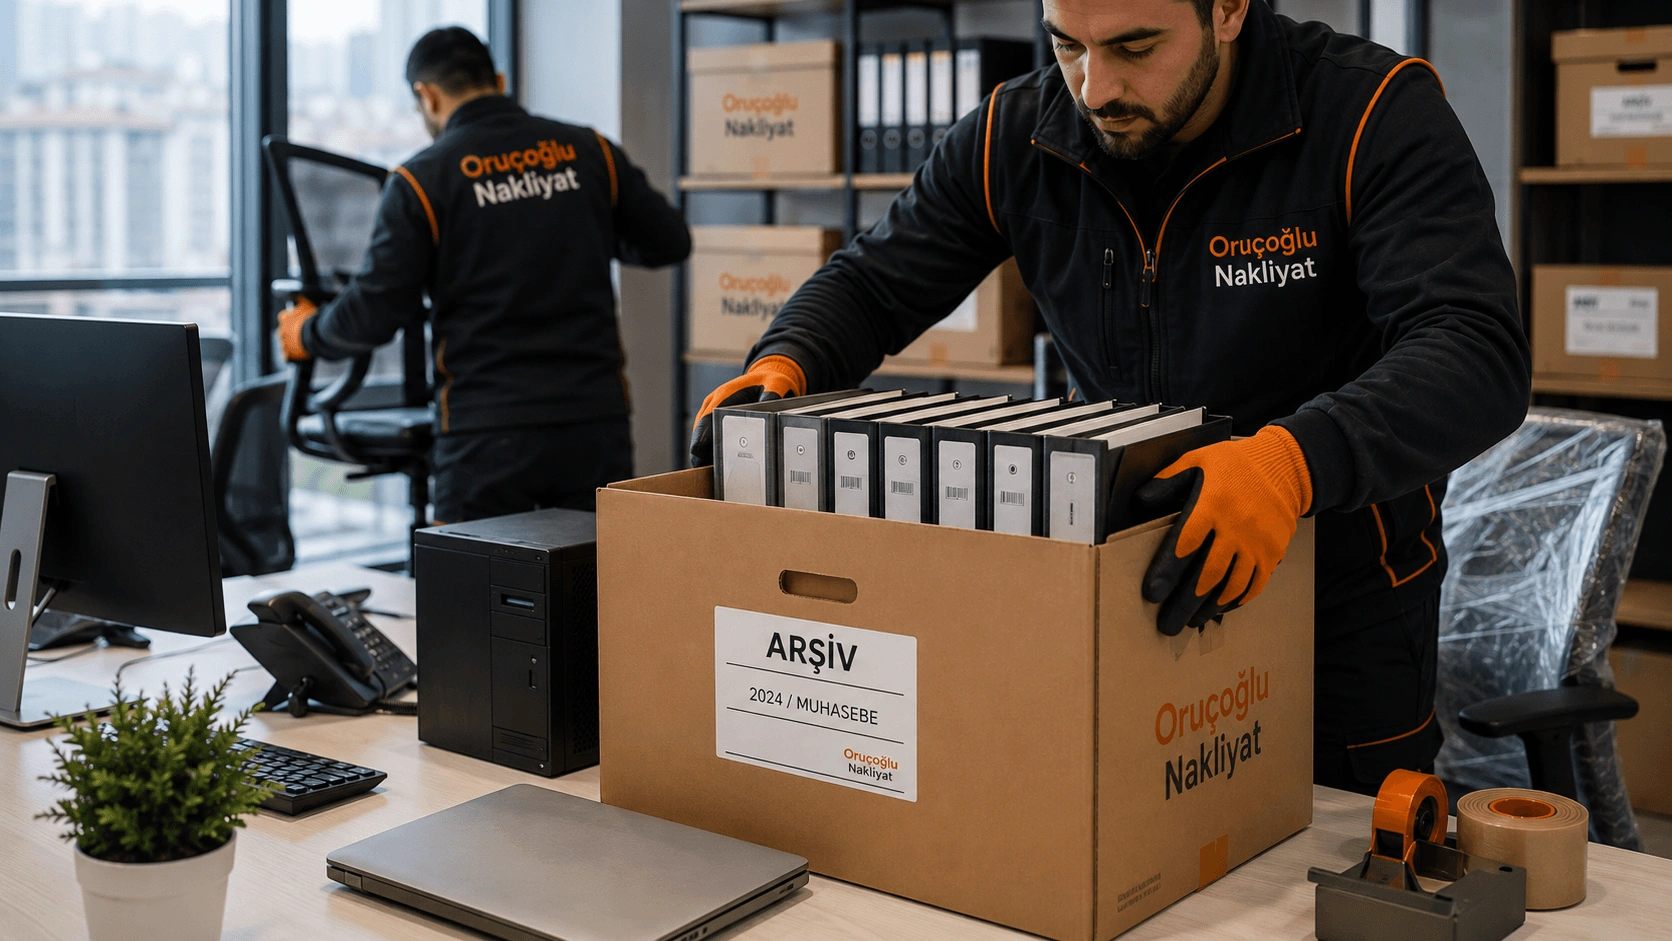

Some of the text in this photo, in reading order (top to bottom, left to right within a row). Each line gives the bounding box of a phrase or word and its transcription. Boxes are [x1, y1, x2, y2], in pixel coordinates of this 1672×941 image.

[460, 139, 577, 178] Oruçoğlu
[473, 166, 580, 208] Nakliyat
[1209, 226, 1317, 259] Oruçoğlu
[1215, 257, 1317, 288] Nakliyat
[766, 632, 858, 674] ARŞİV
[749, 687, 878, 726] 2024 / MUHASEBE
[1155, 666, 1269, 746] Oruçoğlu
[843, 748, 898, 771] Oruçoğlu
[848, 763, 893, 782] Nakliyat
[1165, 720, 1262, 800] Nakliyat
